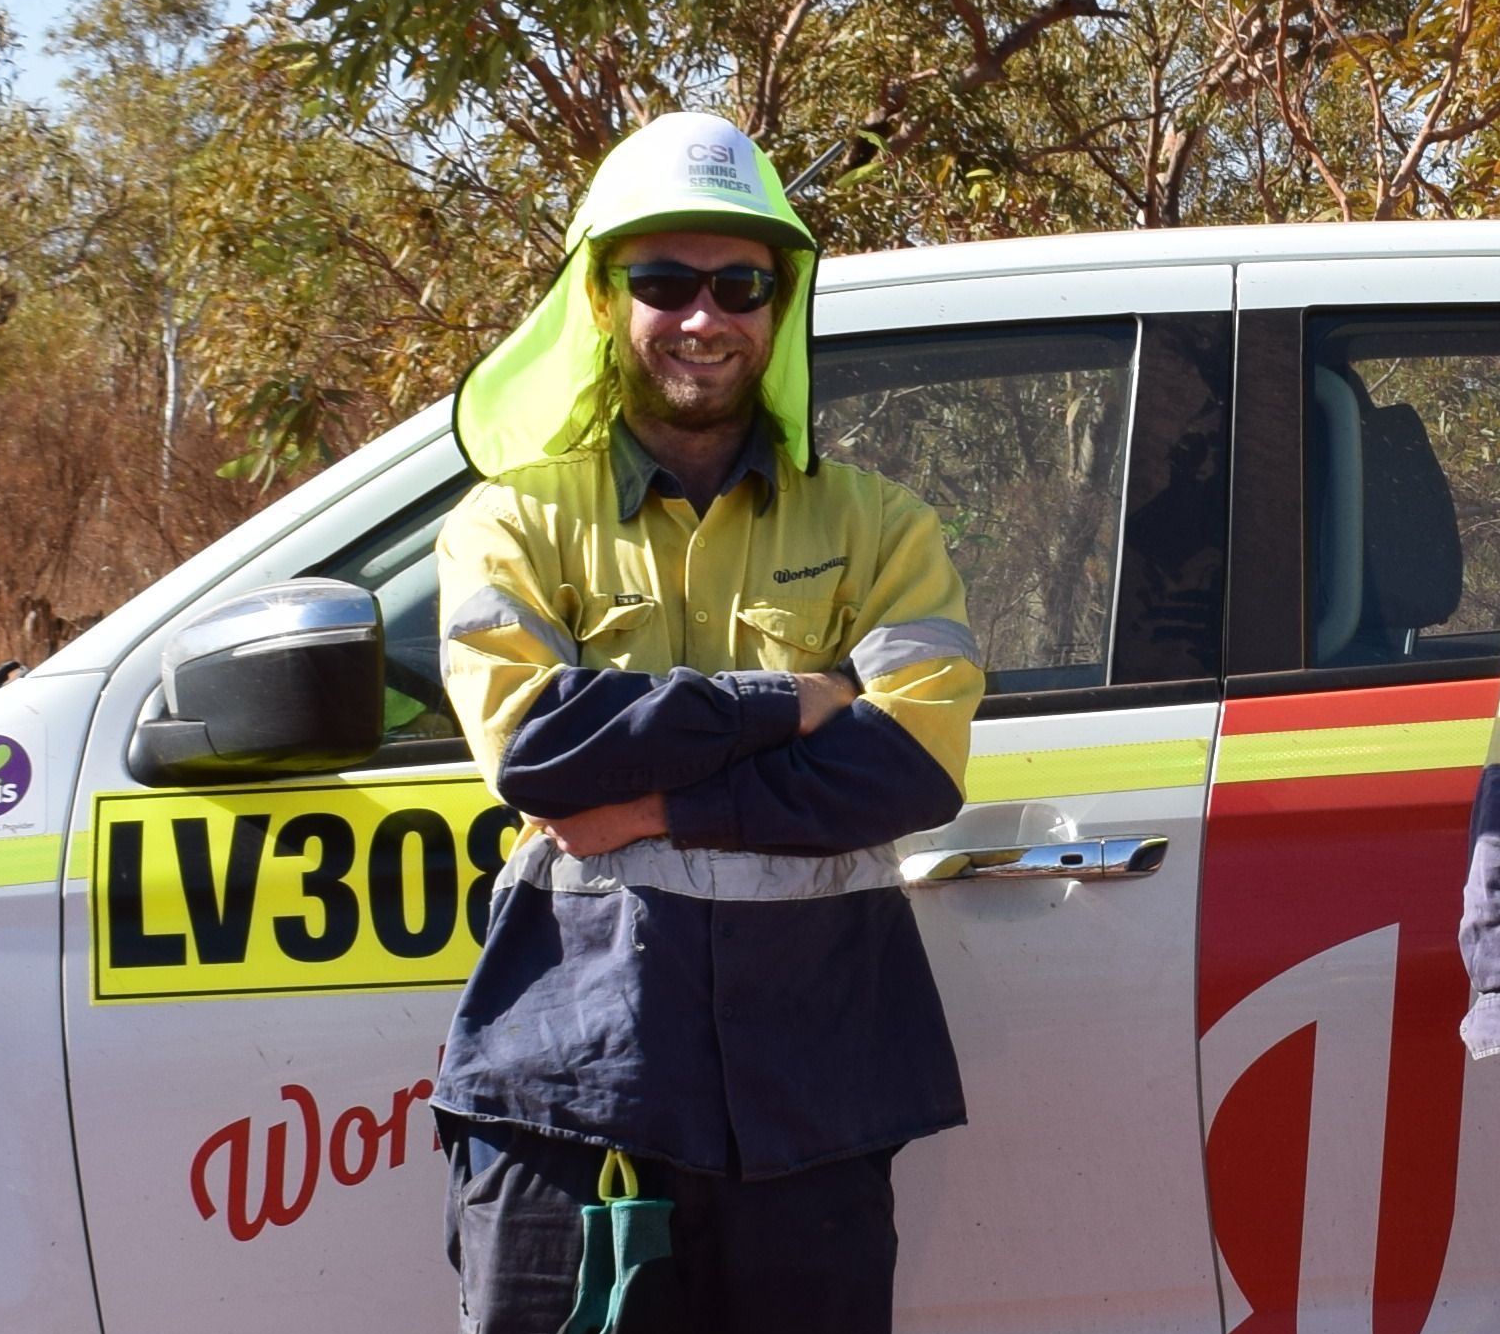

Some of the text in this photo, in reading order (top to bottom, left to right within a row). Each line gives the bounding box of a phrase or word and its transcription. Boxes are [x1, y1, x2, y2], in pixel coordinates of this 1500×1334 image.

[687, 143, 736, 165] CSI
[688, 164, 738, 179] MINING
[689, 177, 752, 194] SERVICES
[190, 1043, 446, 1242] Wor
